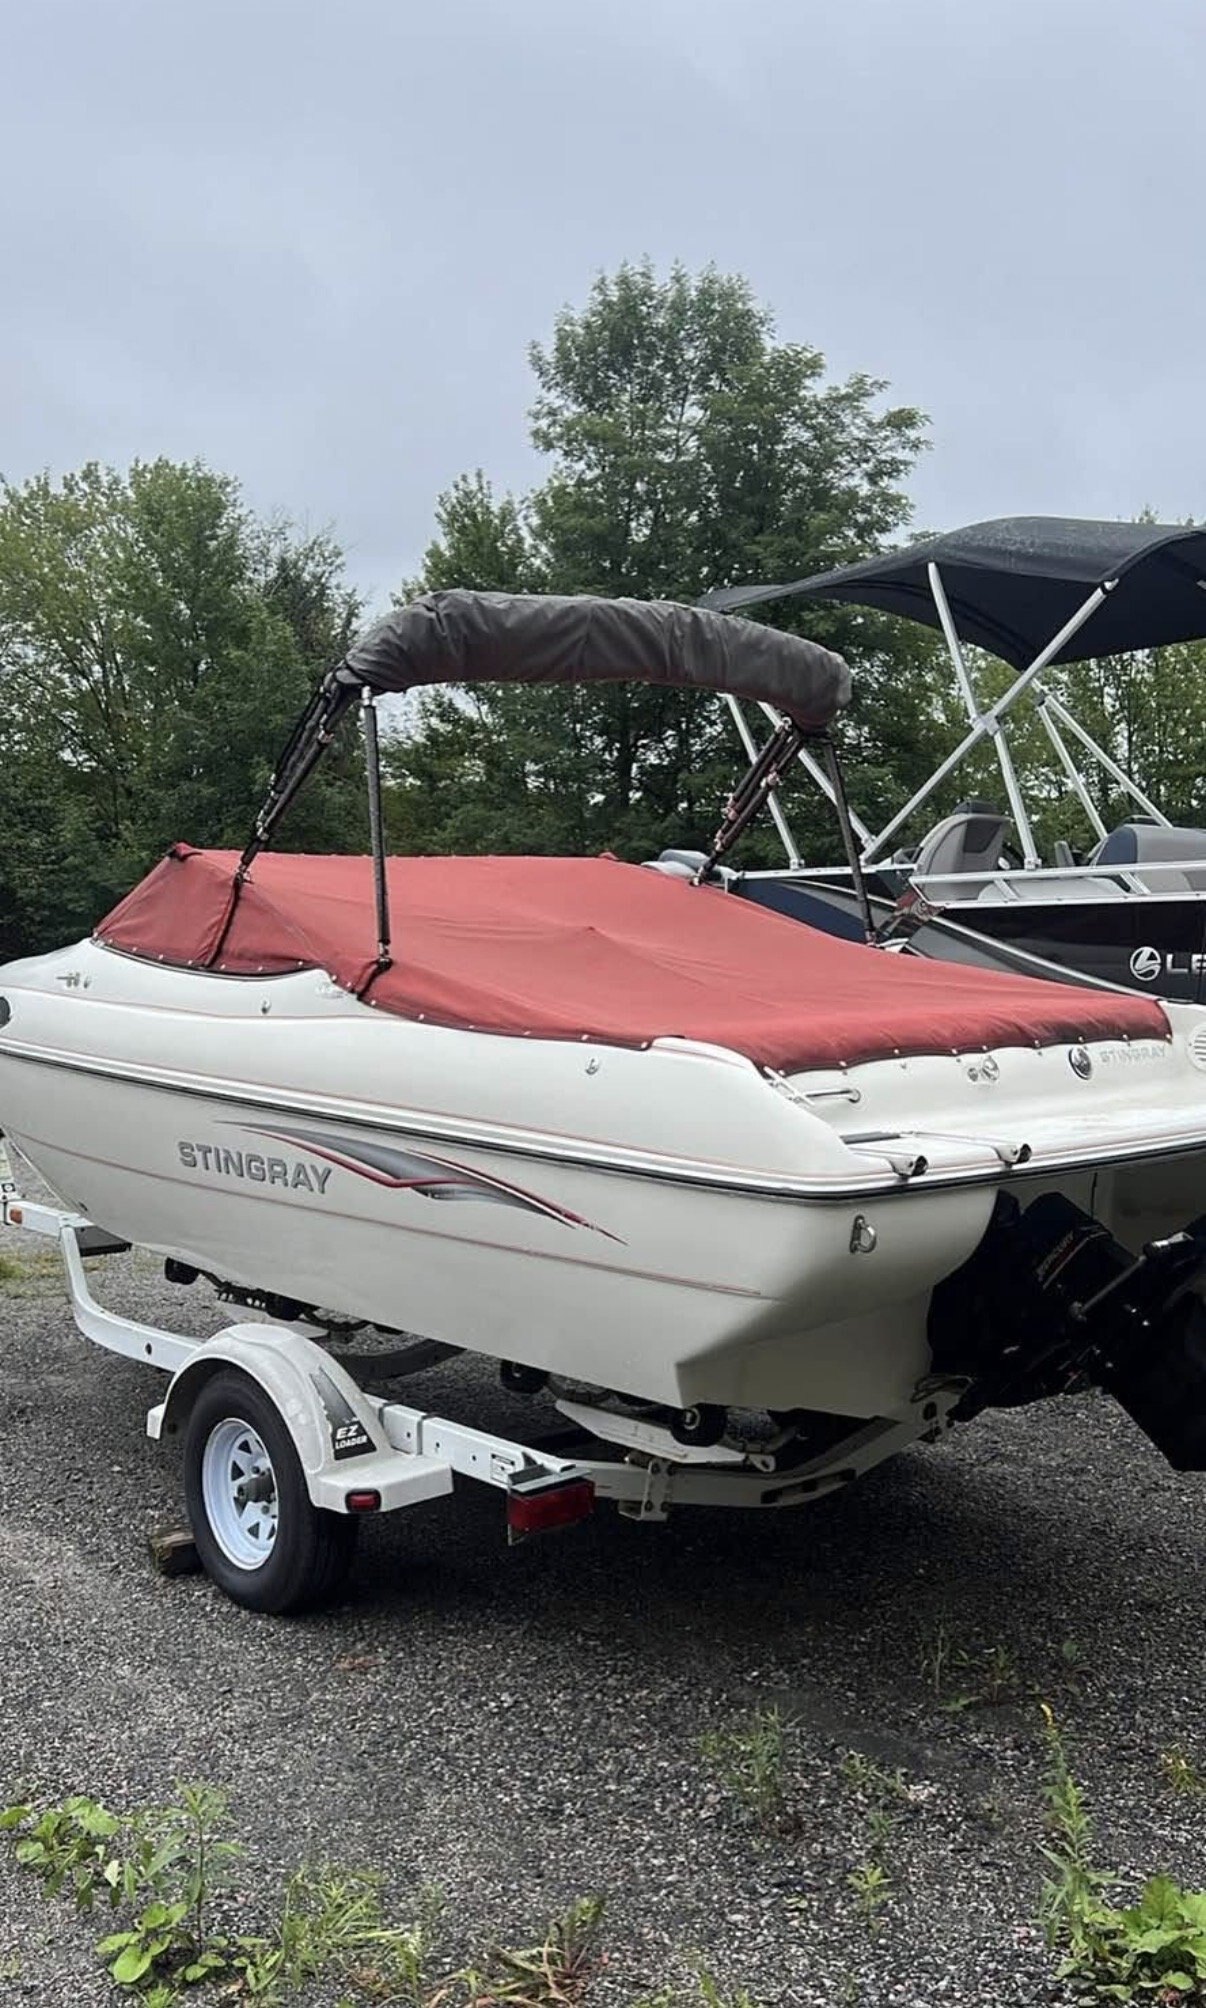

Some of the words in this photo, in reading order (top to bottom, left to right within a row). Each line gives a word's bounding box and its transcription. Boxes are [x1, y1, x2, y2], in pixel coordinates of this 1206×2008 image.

[1099, 1044, 1165, 1062] STINGRAY
[177, 1141, 332, 1195] STINGRAY
[335, 1424, 358, 1440] EZ
[335, 1435, 368, 1450] LOADER
